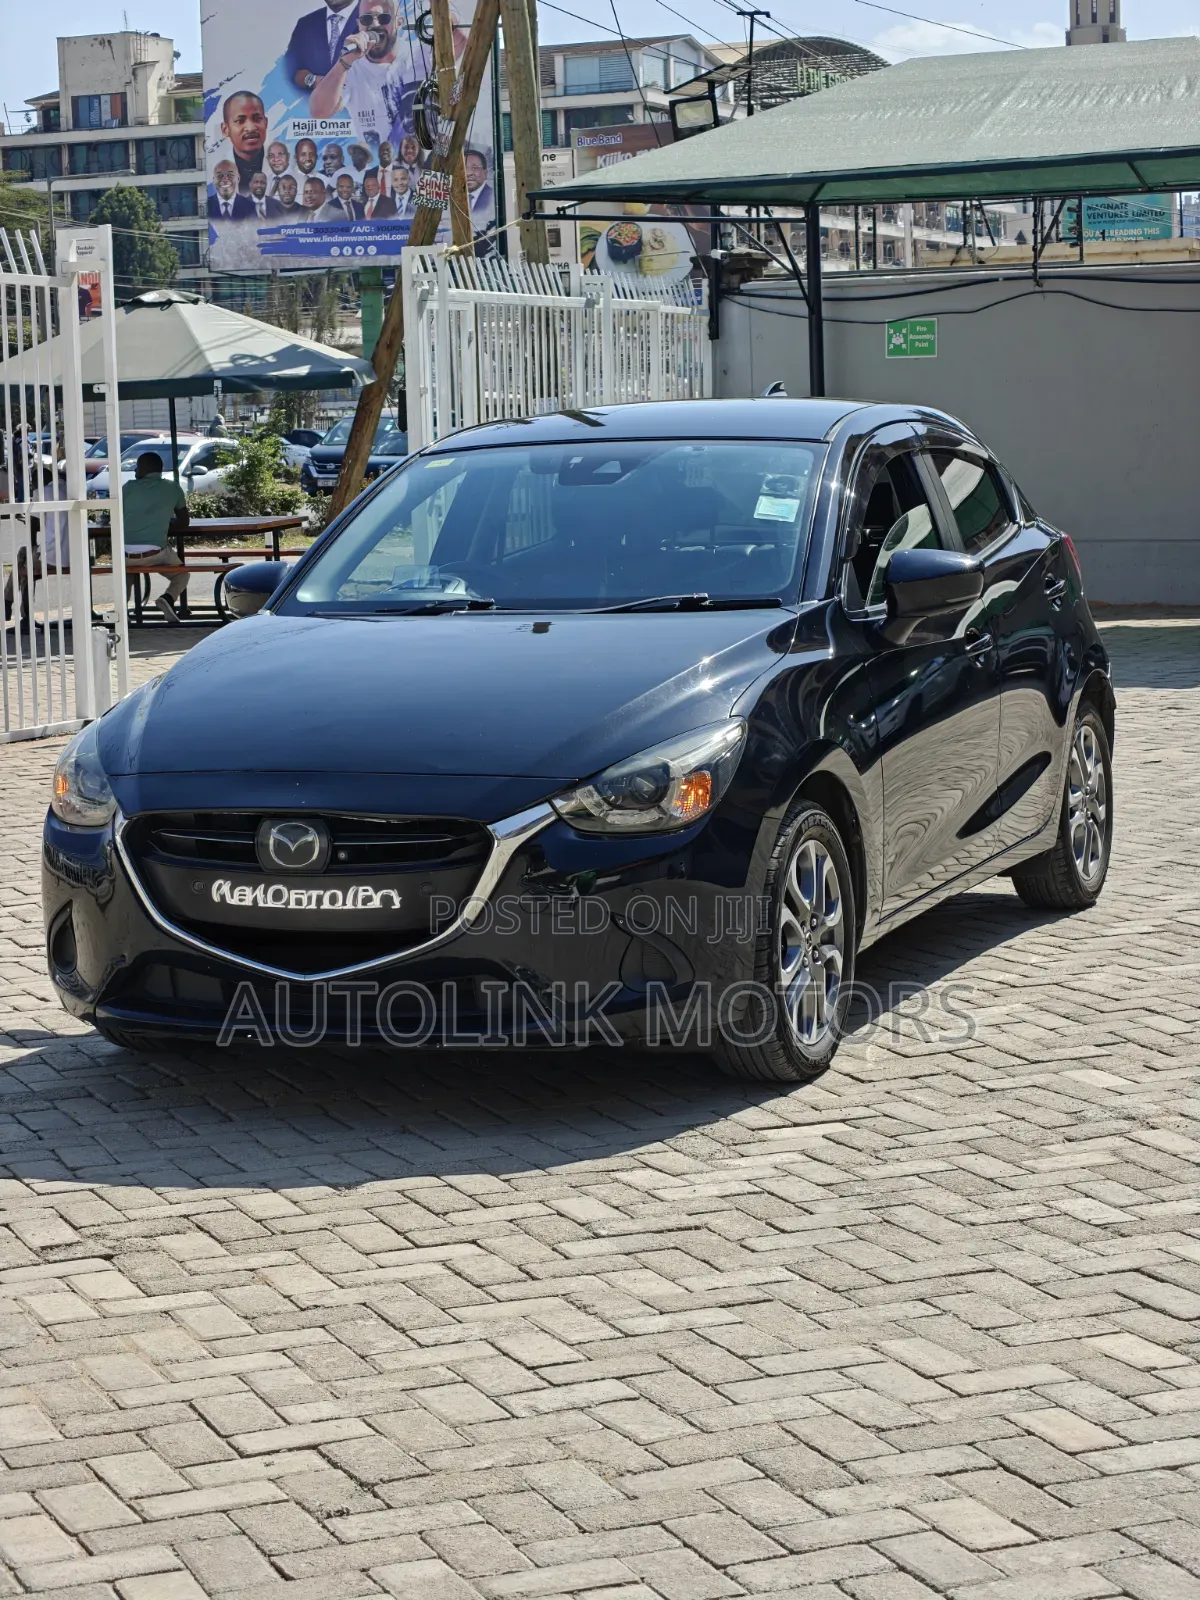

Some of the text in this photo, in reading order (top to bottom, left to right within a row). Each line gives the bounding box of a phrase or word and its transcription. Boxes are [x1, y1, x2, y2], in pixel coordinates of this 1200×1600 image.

[293, 120, 351, 132] Hajji Omar
[577, 132, 622, 146] Blue Band
[1086, 203, 1129, 211] MAGNATE
[1086, 208, 1166, 220] VENTURES LIMITED
[1110, 228, 1142, 236] READING
[1144, 227, 1160, 235] THIS
